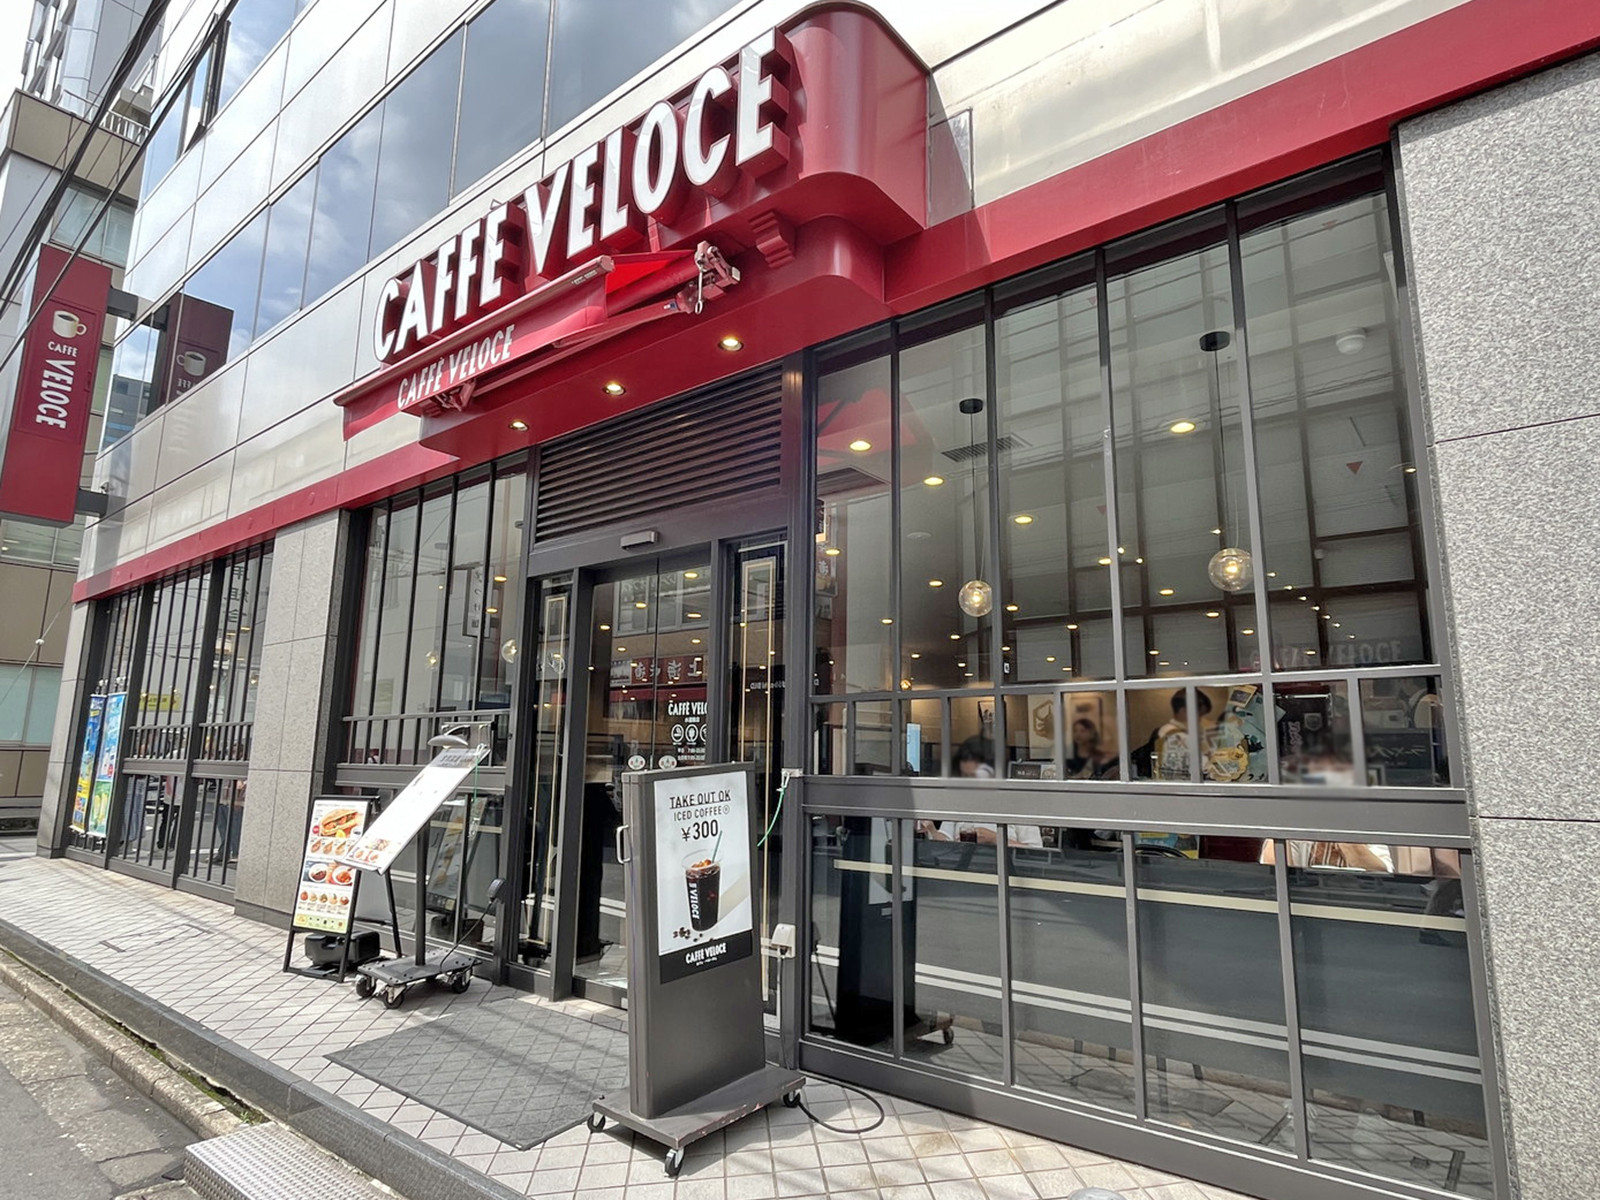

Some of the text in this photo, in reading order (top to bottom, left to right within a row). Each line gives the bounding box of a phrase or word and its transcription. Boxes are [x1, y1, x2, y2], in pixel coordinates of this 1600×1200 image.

[525, 26, 777, 278] VELOCE
[449, 324, 515, 384] VELOCE
[36, 359, 76, 429] VELOCE
[669, 789, 731, 809] TAKE OUT OK
[673, 810, 693, 821] ICED
[694, 805, 722, 819] COFFEE
[681, 819, 719, 842] ¥300
[704, 942, 727, 958] VELOCE
